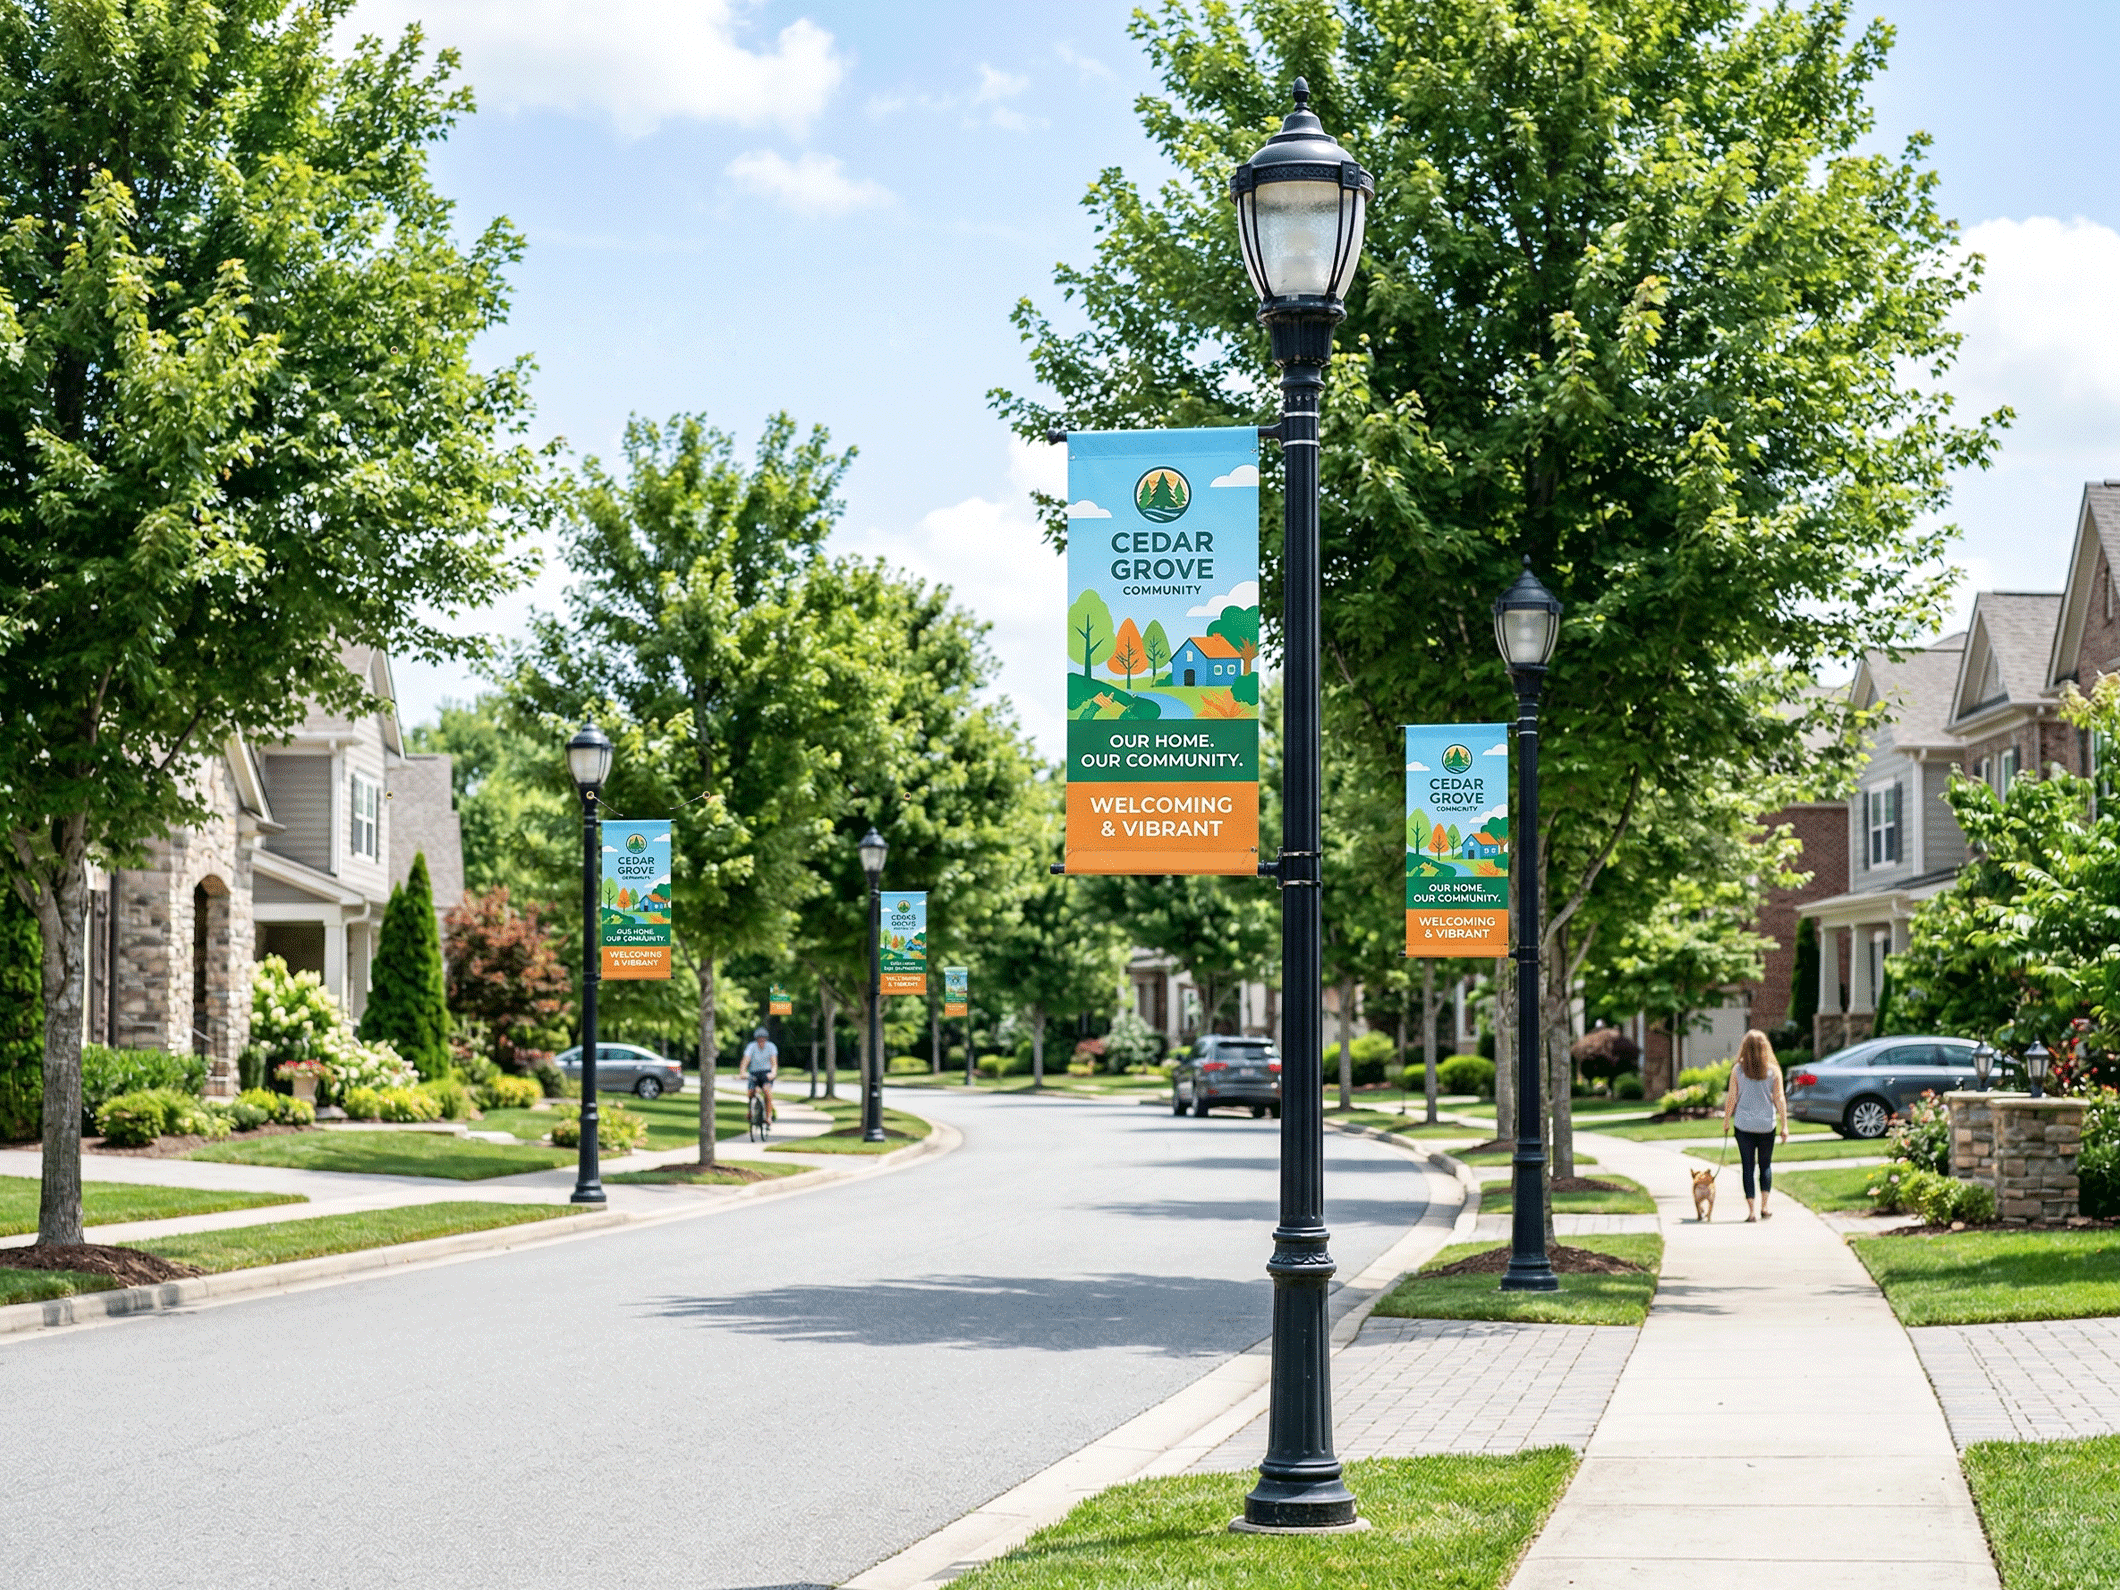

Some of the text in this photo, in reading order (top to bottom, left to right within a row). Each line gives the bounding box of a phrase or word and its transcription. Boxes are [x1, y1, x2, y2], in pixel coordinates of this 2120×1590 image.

[1111, 531, 1214, 553] CEDAR
[1111, 558, 1214, 580] GROVE
[1123, 585, 1201, 595] COMMUNITY
[1110, 734, 1214, 748] OUR HOME.
[1081, 754, 1243, 767] OUR COMMUNITY.
[1430, 779, 1483, 790] CEDAR
[1430, 792, 1484, 804] GROVE
[1090, 796, 1232, 814] WELCOMING
[1101, 820, 1222, 837] & VIBRANT
[1414, 894, 1501, 902] OUR COMMUNITY.
[1419, 917, 1495, 926] WELCOMING
[1425, 929, 1490, 938] & VIBRANT
